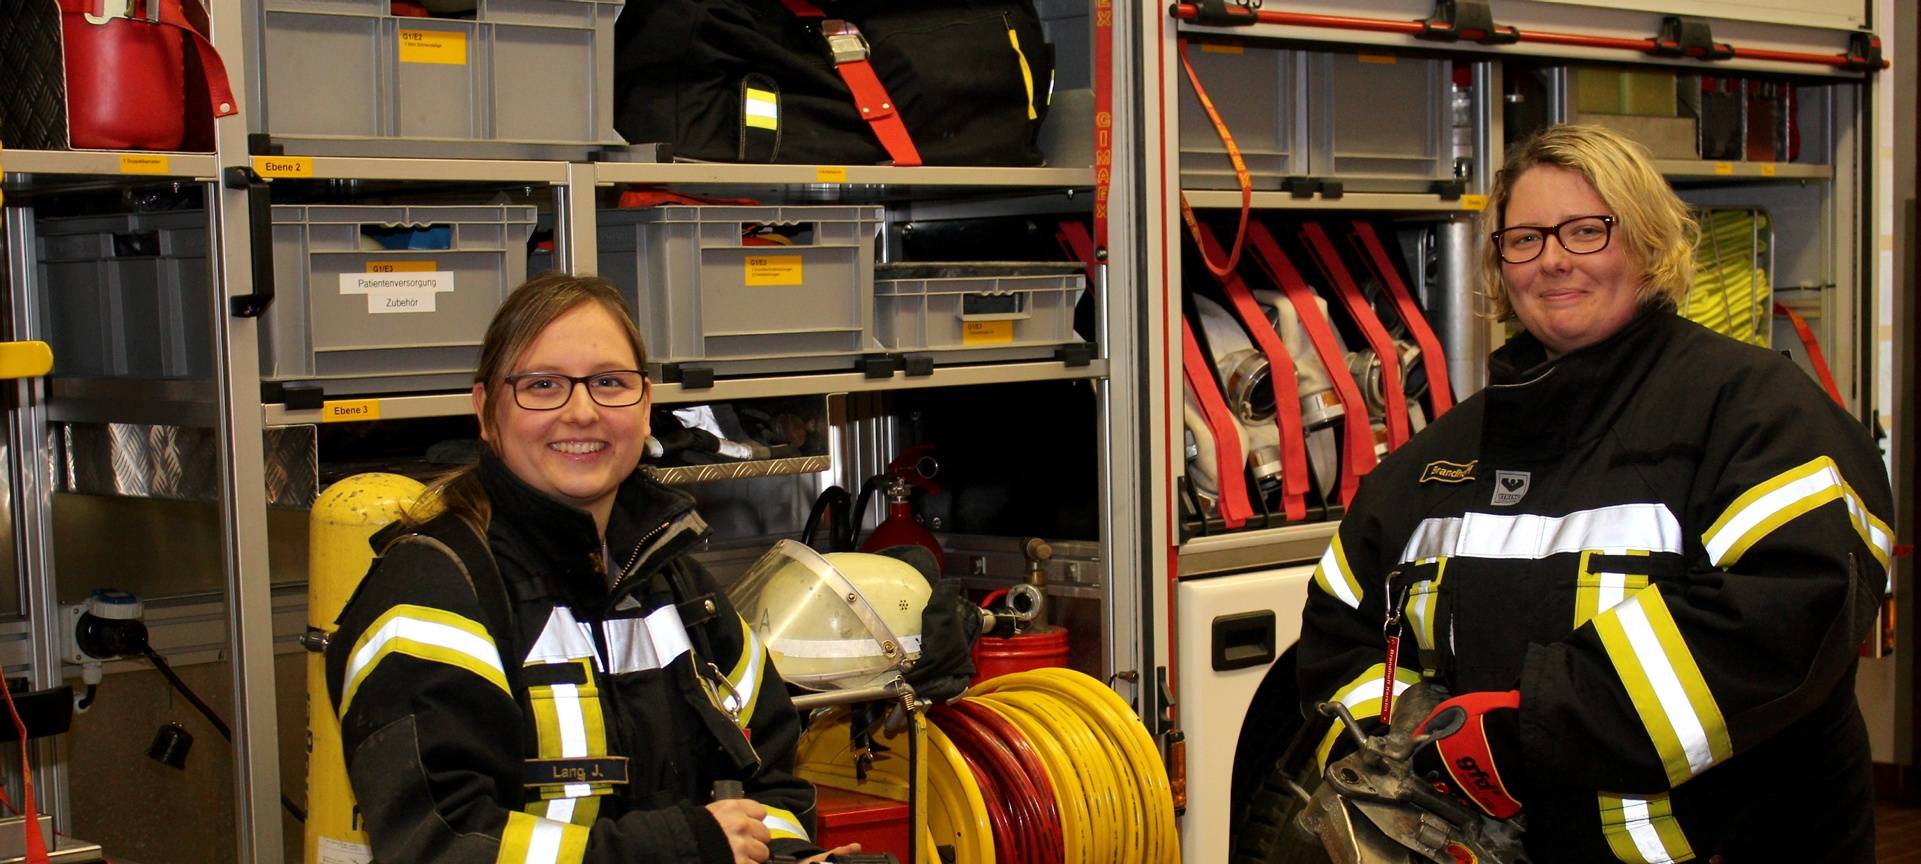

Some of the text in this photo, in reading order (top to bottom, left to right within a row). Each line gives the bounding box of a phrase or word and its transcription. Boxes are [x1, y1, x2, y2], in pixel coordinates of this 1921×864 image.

[265, 162, 301, 172] Ebene 2
[1096, 112, 1112, 218] GIMAEX
[358, 278, 437, 288] Patientenversorgung
[386, 298, 418, 308] Zubehör
[334, 405, 368, 415] Ebene 3
[553, 763, 604, 782] Lang J.
